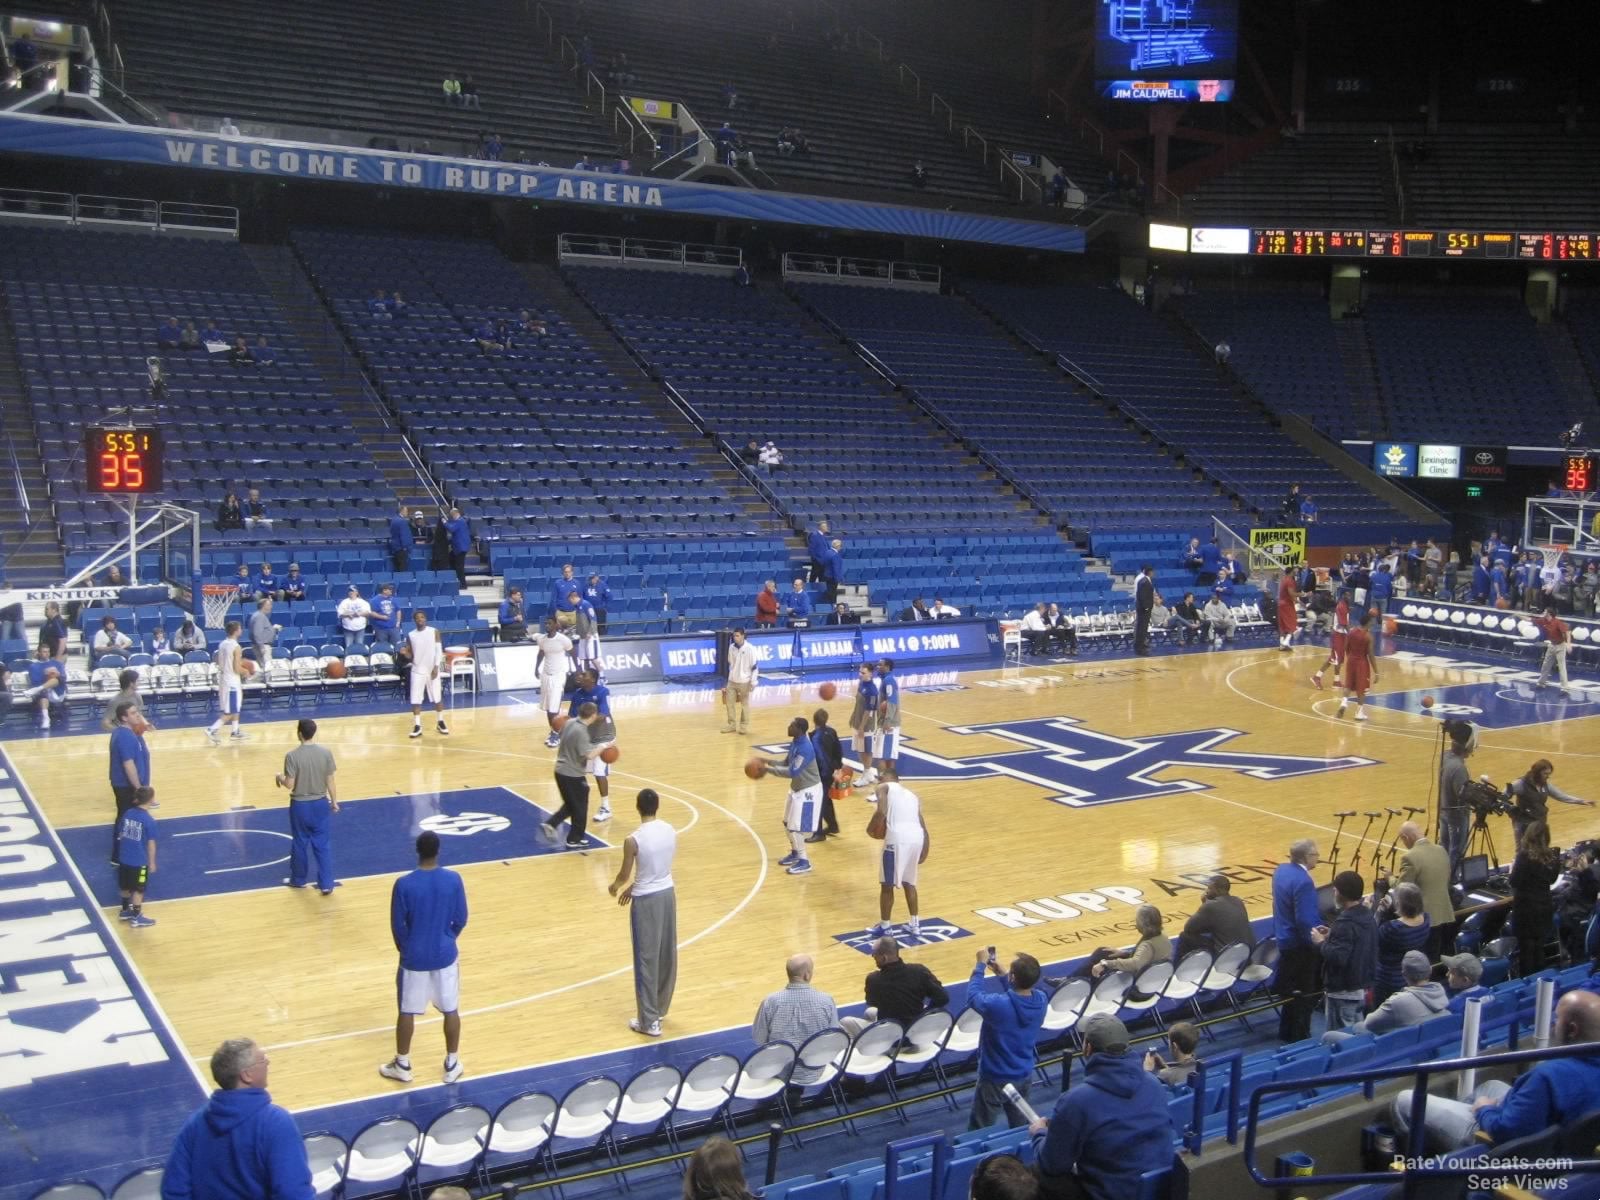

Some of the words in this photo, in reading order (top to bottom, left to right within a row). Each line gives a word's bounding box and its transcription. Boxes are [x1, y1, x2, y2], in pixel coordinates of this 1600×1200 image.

[1114, 89, 1131, 98] JIM
[1133, 89, 1186, 98] CALDWELL
[165, 140, 358, 178] WELCOME
[380, 160, 422, 184] TO
[446, 167, 538, 194] RUPP
[556, 178, 663, 207] ARENA
[106, 433, 149, 452] 5:51
[1421, 456, 1457, 465] Lexington
[1569, 458, 1591, 470] 5:51
[102, 454, 143, 487] 35
[1429, 465, 1448, 474] Clinic
[1466, 465, 1504, 474] TOYOTA
[1567, 470, 1586, 489] 35
[26, 589, 121, 600] KENTUCKY
[668, 649, 697, 666] NEXT
[811, 640, 856, 657] ALABAM
[873, 638, 897, 653] MAR
[898, 637, 906, 652] 4
[907, 636, 919, 651] @
[921, 634, 960, 650] 9:00PM
[972, 886, 1144, 929] RUPP
